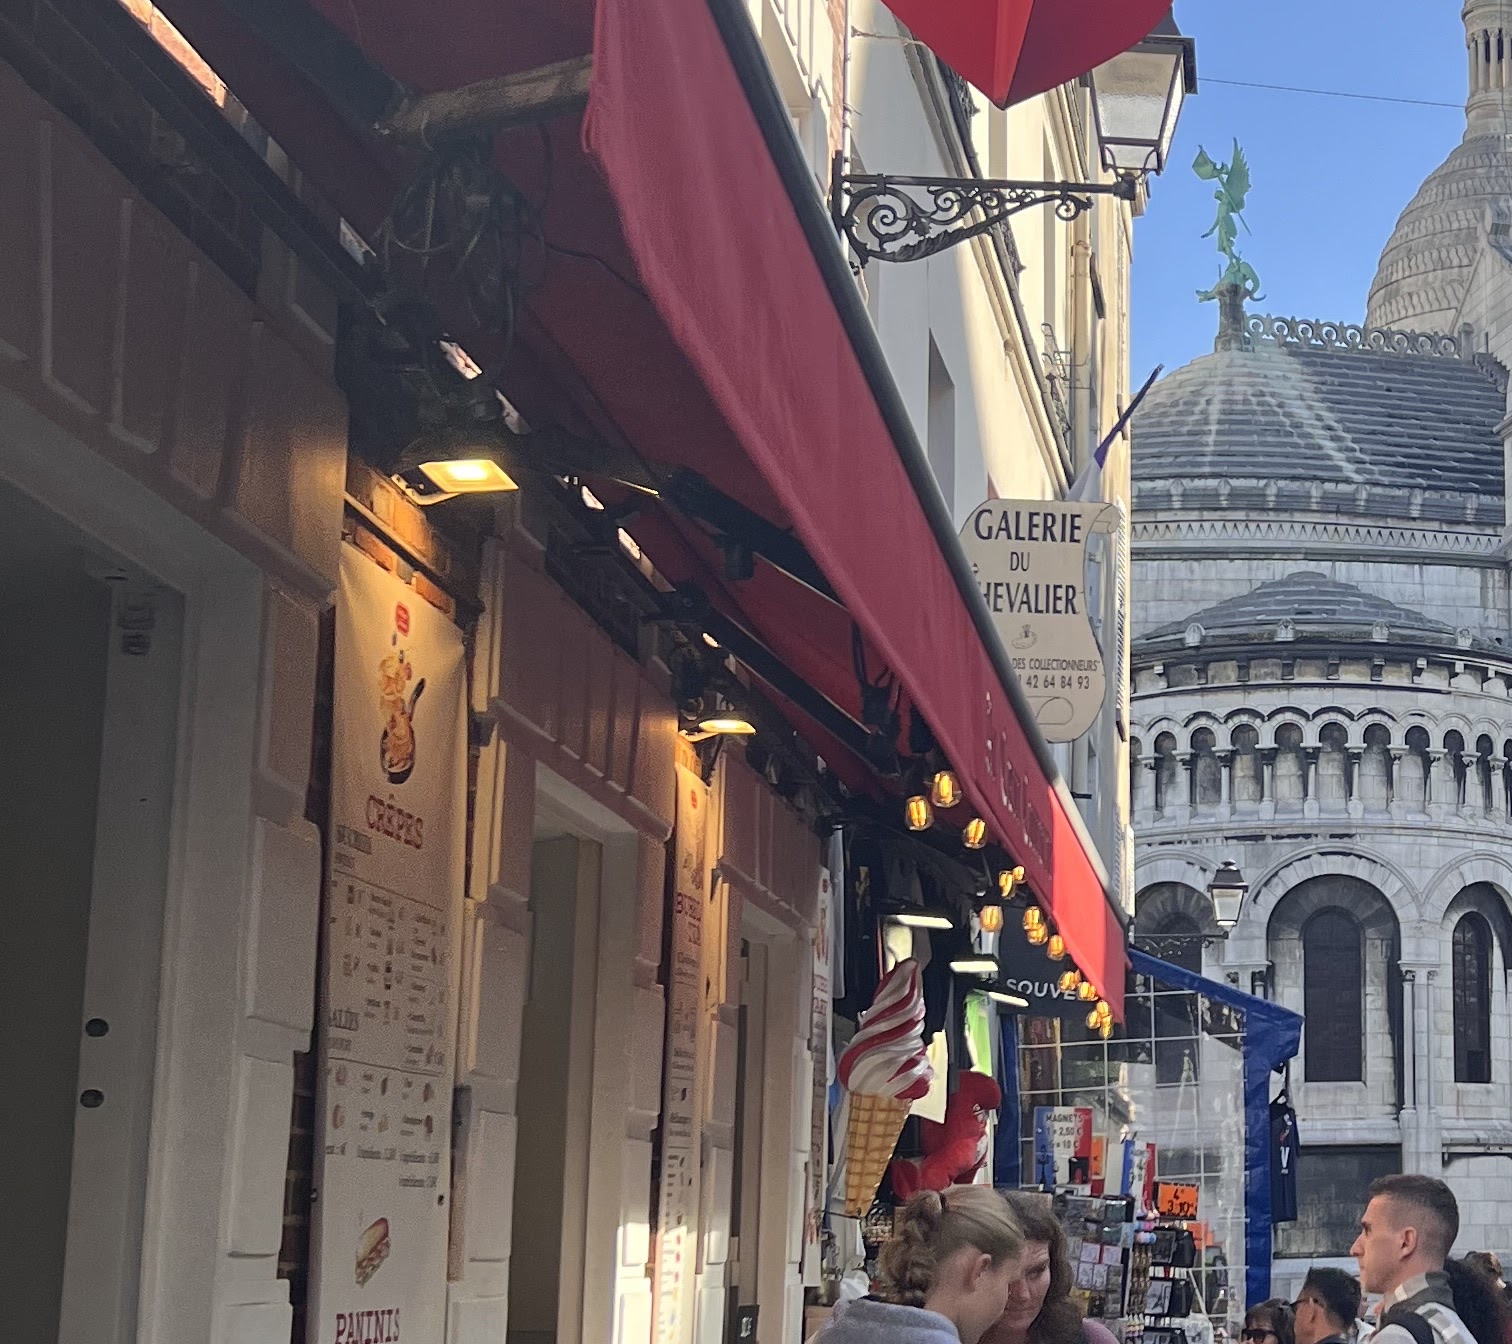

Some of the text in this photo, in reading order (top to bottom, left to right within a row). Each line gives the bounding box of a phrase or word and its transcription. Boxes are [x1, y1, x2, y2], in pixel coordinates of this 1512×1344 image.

[974, 508, 1083, 544] GALERIE
[1009, 551, 1031, 572] DU
[978, 581, 1080, 615] HEVALIER
[1025, 674, 1039, 689] 42
[1043, 674, 1056, 689] 64
[1060, 675, 1073, 690] 84
[1077, 675, 1091, 690] 93
[1006, 978, 1078, 1001] SOUVE
